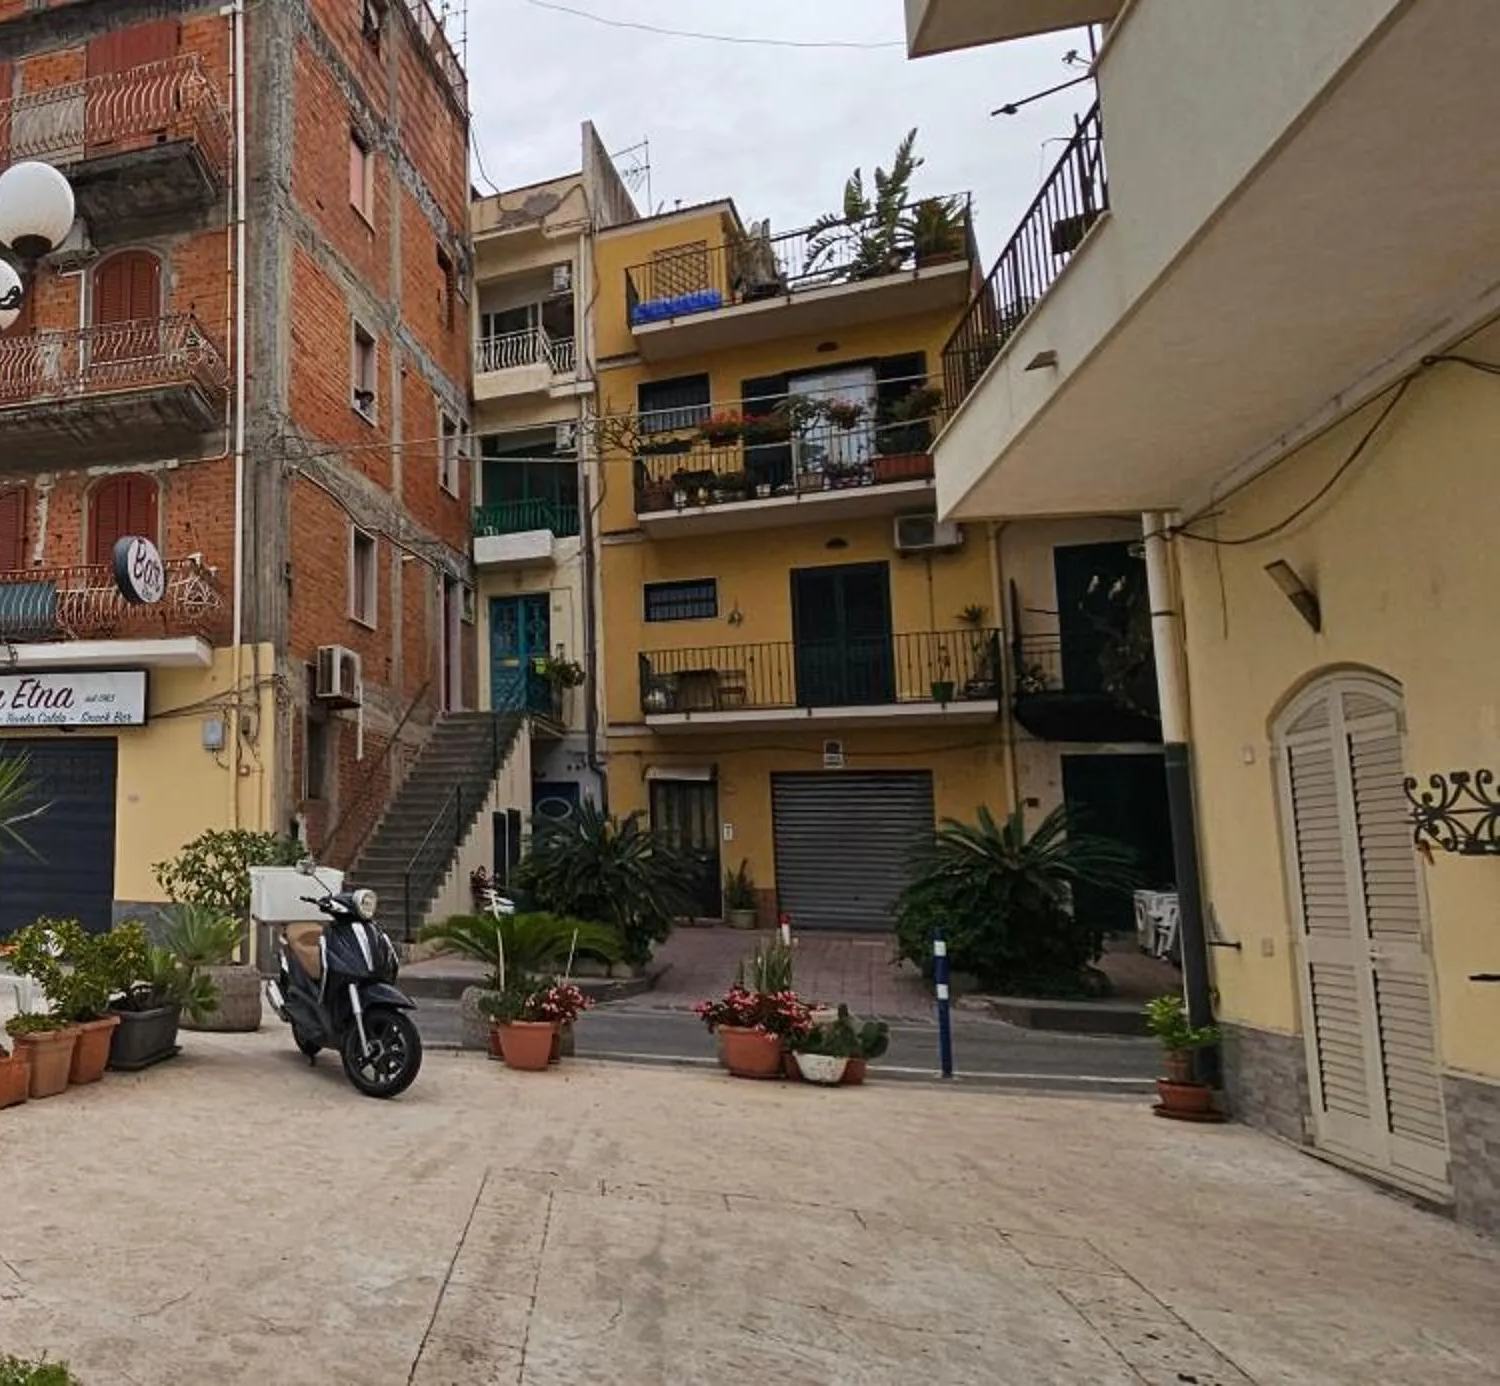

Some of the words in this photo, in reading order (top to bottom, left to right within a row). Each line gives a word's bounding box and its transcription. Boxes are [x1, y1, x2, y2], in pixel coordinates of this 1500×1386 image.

[133, 538, 162, 590] Bar
[11, 677, 75, 709] Etna
[113, 710, 133, 722] Bar
